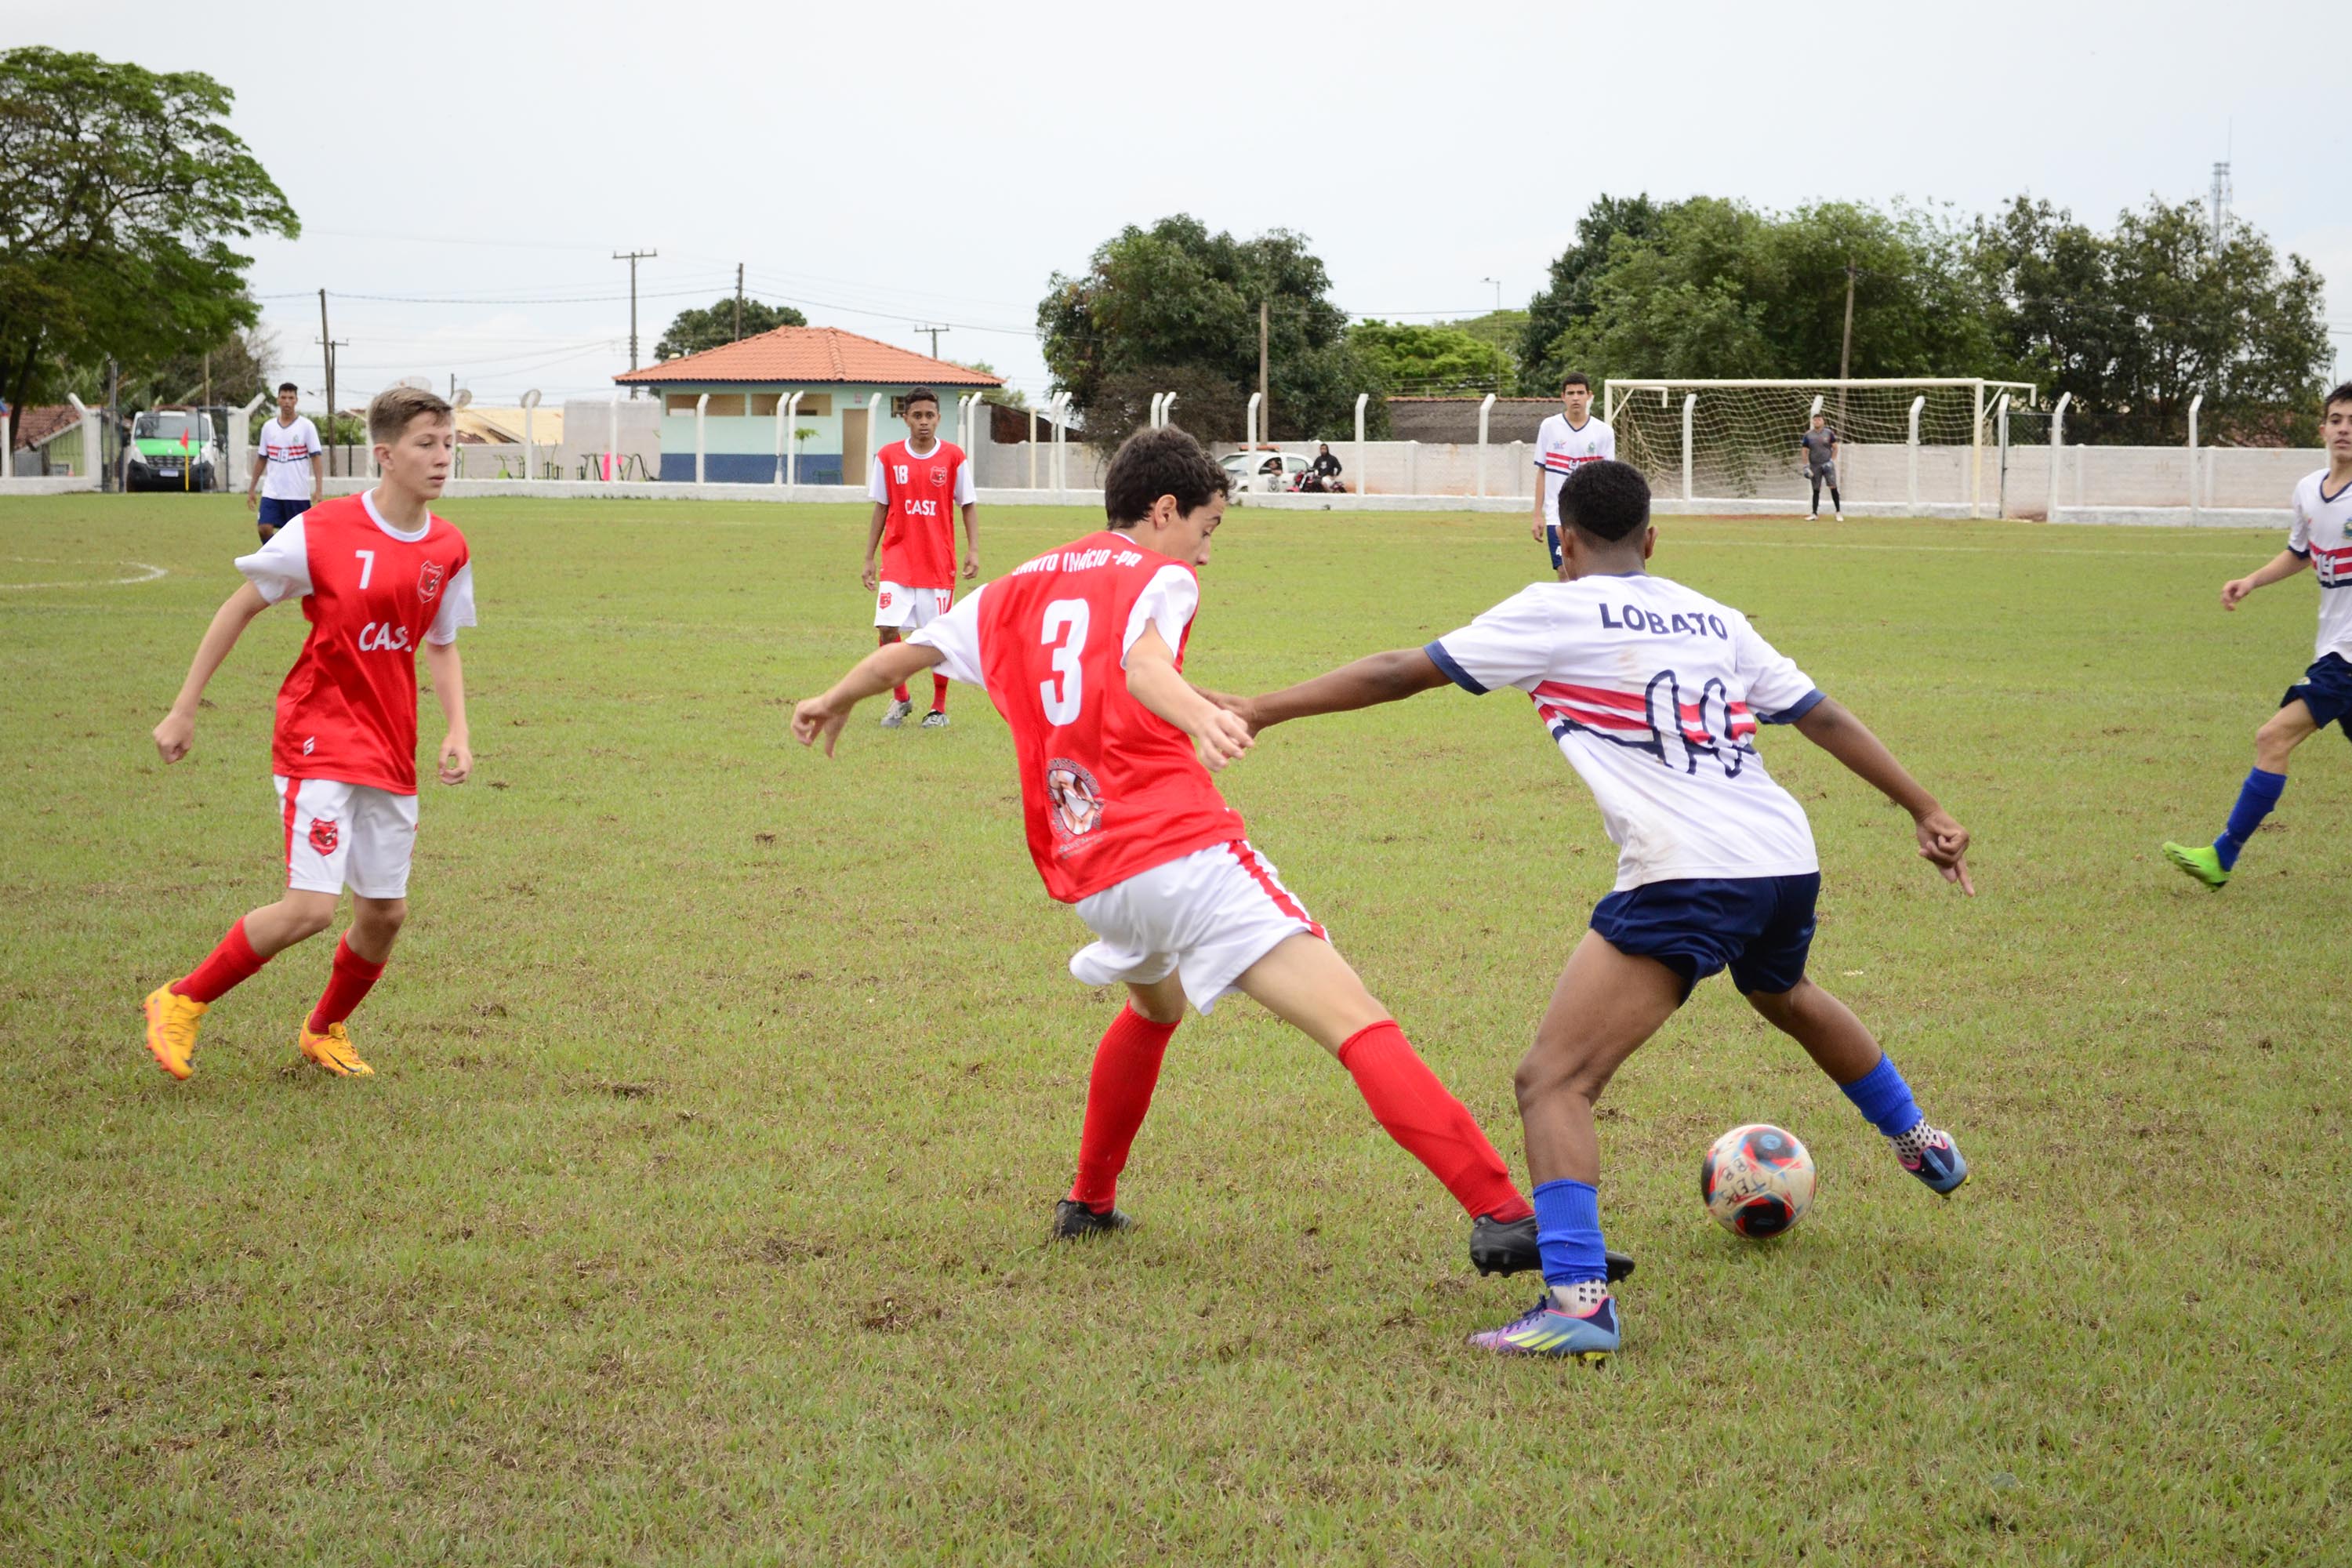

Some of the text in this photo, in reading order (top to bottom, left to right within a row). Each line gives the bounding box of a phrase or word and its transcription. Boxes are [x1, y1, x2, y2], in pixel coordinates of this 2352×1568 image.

[892, 464, 909, 485] 18
[905, 499, 937, 516] CASI
[355, 550, 375, 590] 7
[1062, 549, 1111, 572] INÁCIO
[2316, 551, 2336, 586] 14
[1599, 603, 1728, 641] LOBATO
[1040, 598, 1090, 726] 3
